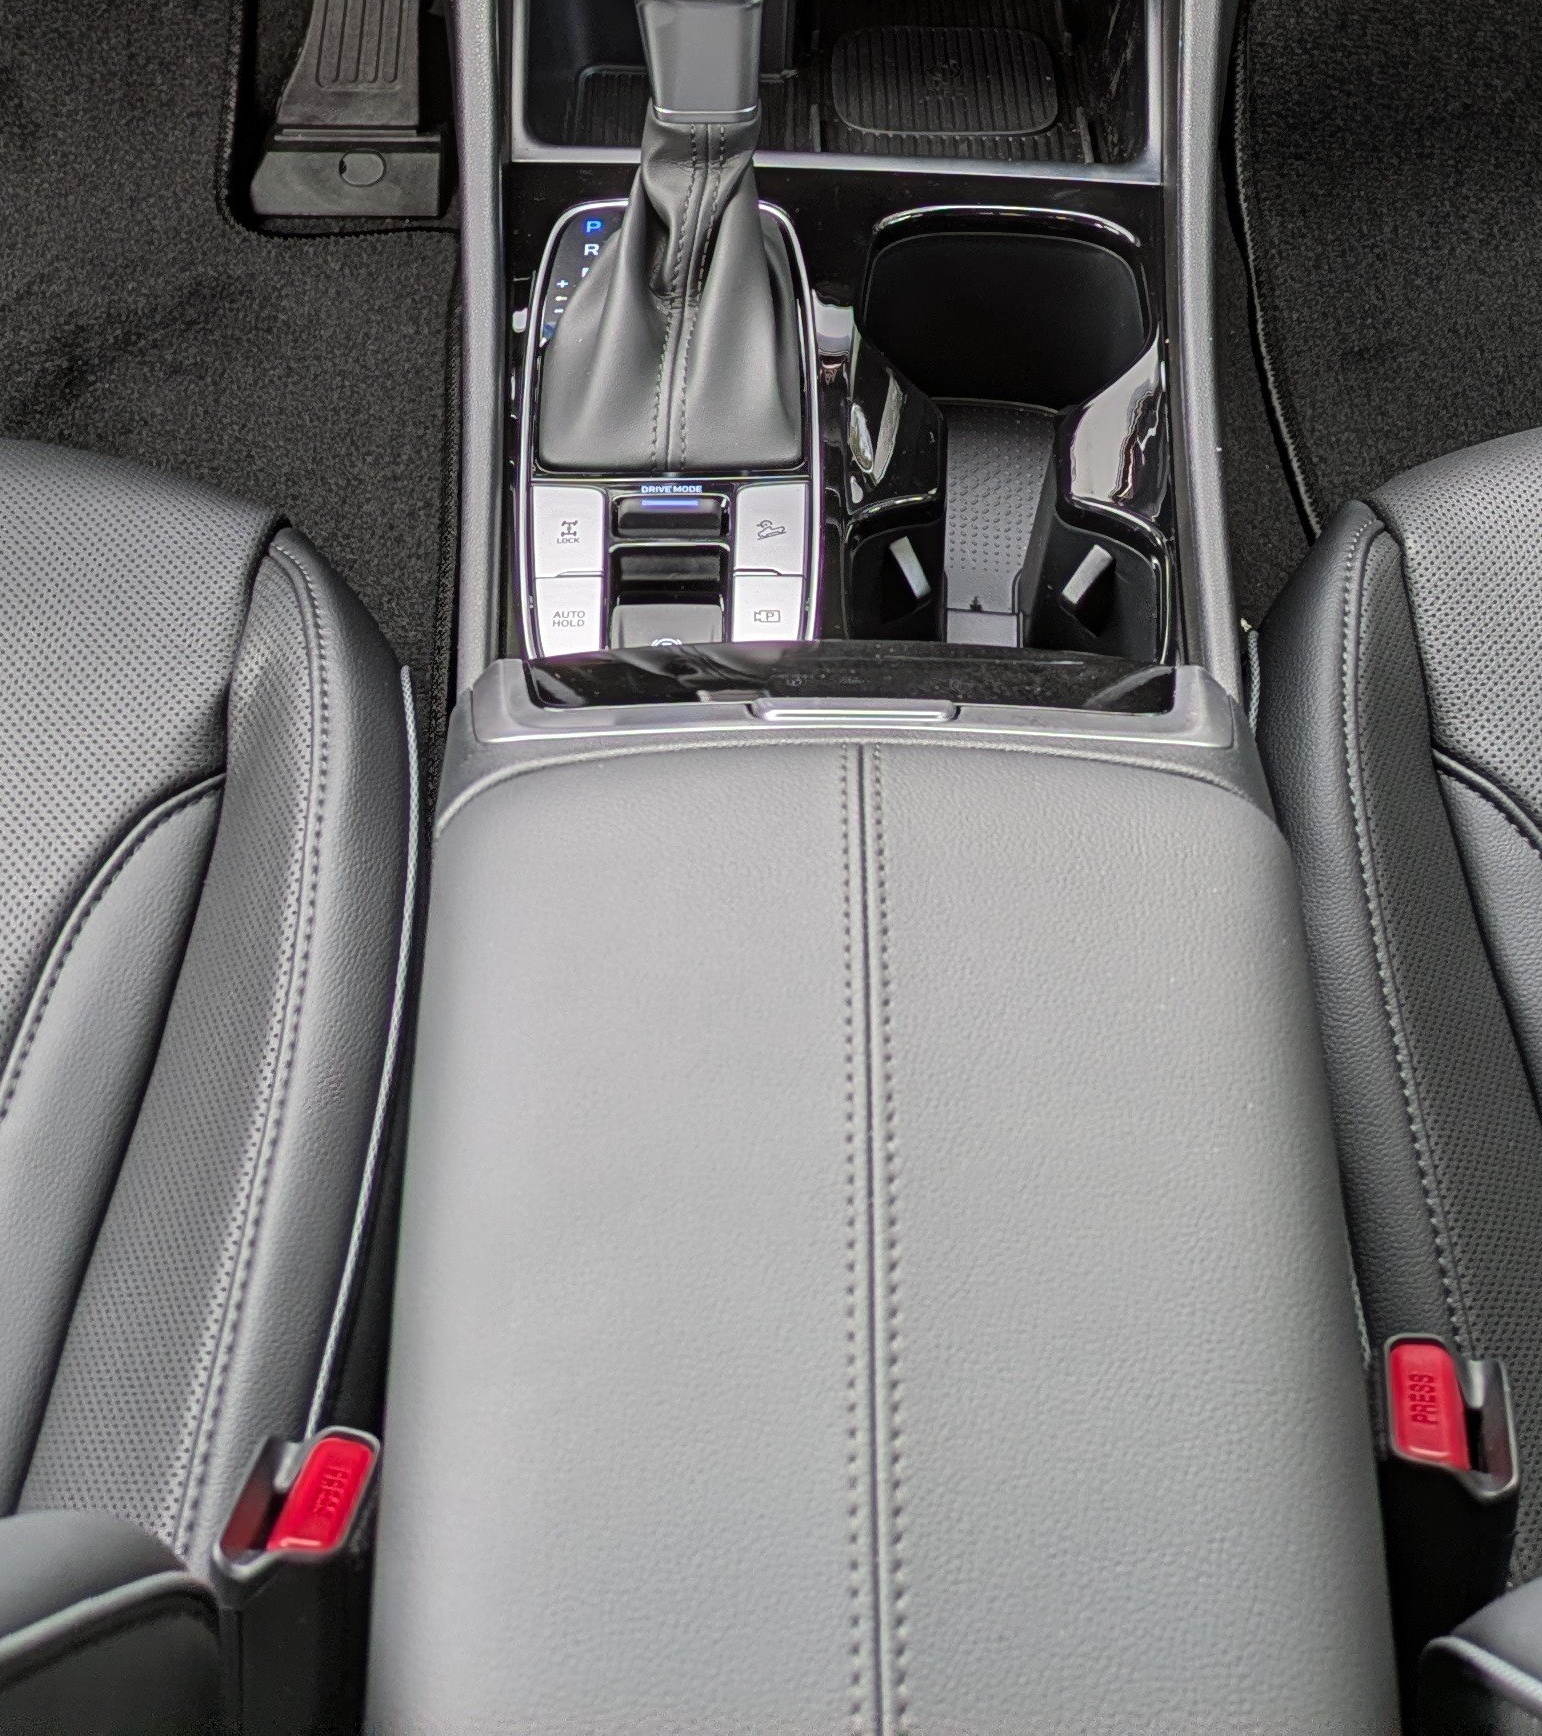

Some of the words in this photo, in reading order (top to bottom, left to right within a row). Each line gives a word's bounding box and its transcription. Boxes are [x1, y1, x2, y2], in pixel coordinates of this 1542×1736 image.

[586, 220, 602, 233] P
[584, 244, 599, 256] R
[641, 485, 671, 494] DRIVE
[673, 485, 703, 494] MODE
[552, 610, 586, 619] AUTO
[552, 618, 585, 628] HOLD
